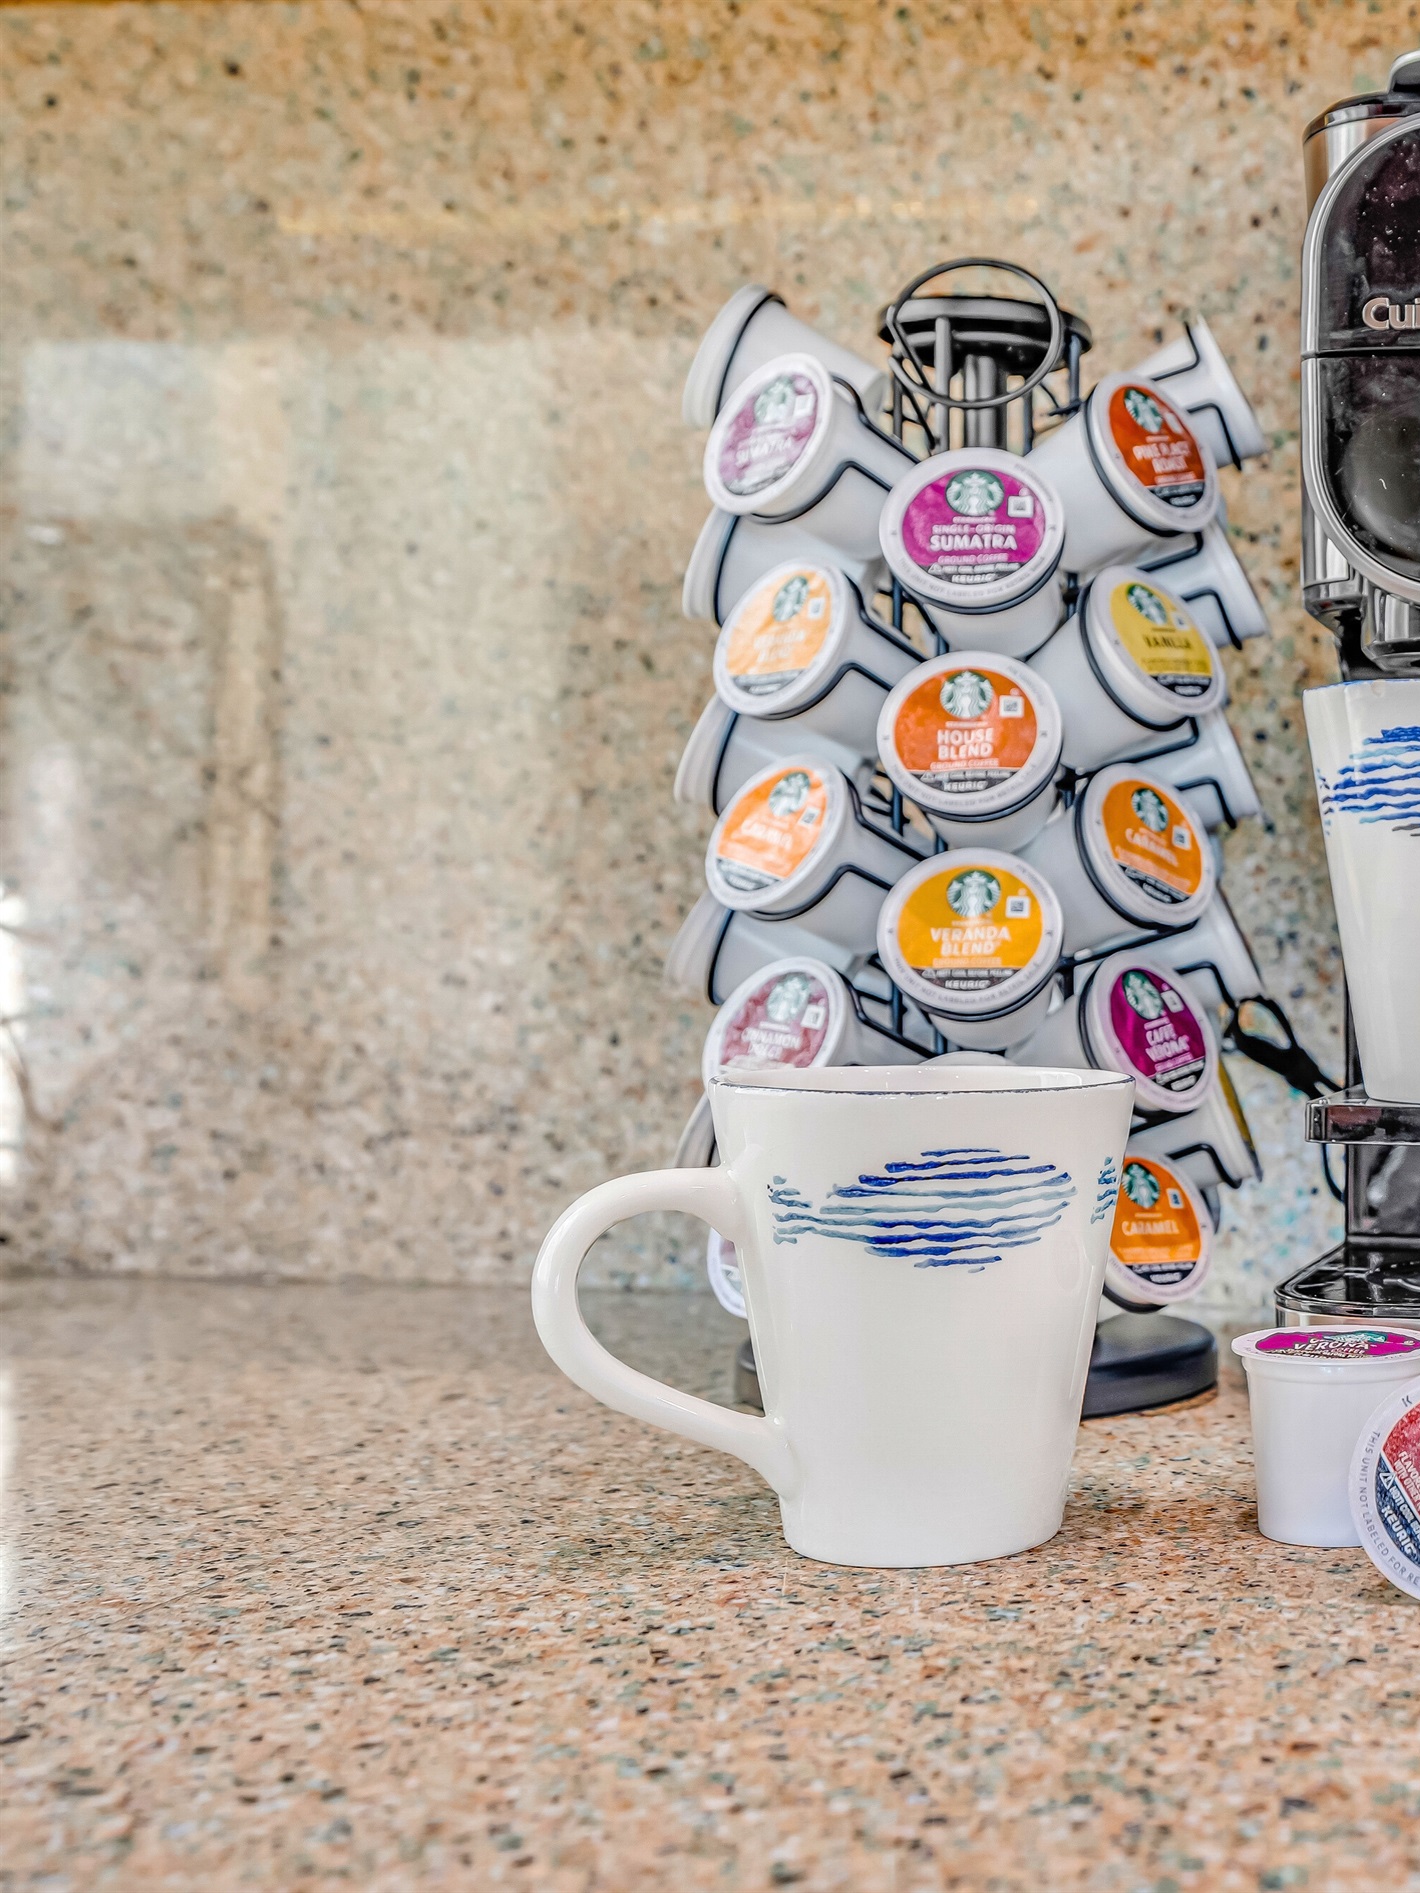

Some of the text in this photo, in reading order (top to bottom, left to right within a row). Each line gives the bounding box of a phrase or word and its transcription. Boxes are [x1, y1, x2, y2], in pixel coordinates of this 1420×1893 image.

[930, 534, 1018, 551] SUMATRA
[937, 728, 994, 746] HOUSE
[938, 743, 993, 760] BLEND
[930, 926, 1012, 943] VERANDA
[940, 940, 995, 956] BLEND
[945, 980, 991, 990] KEURIG
[1121, 1220, 1180, 1236] CARAMEL
[1294, 1340, 1369, 1350] VERONA
[1365, 1431, 1381, 1454] THIS
[1359, 1457, 1371, 1483] UNIT
[1359, 1486, 1369, 1508] NOT
[1362, 1511, 1390, 1557] LABELED
[1382, 1504, 1417, 1556] KEURIG
[1388, 1555, 1407, 1575] FOR
